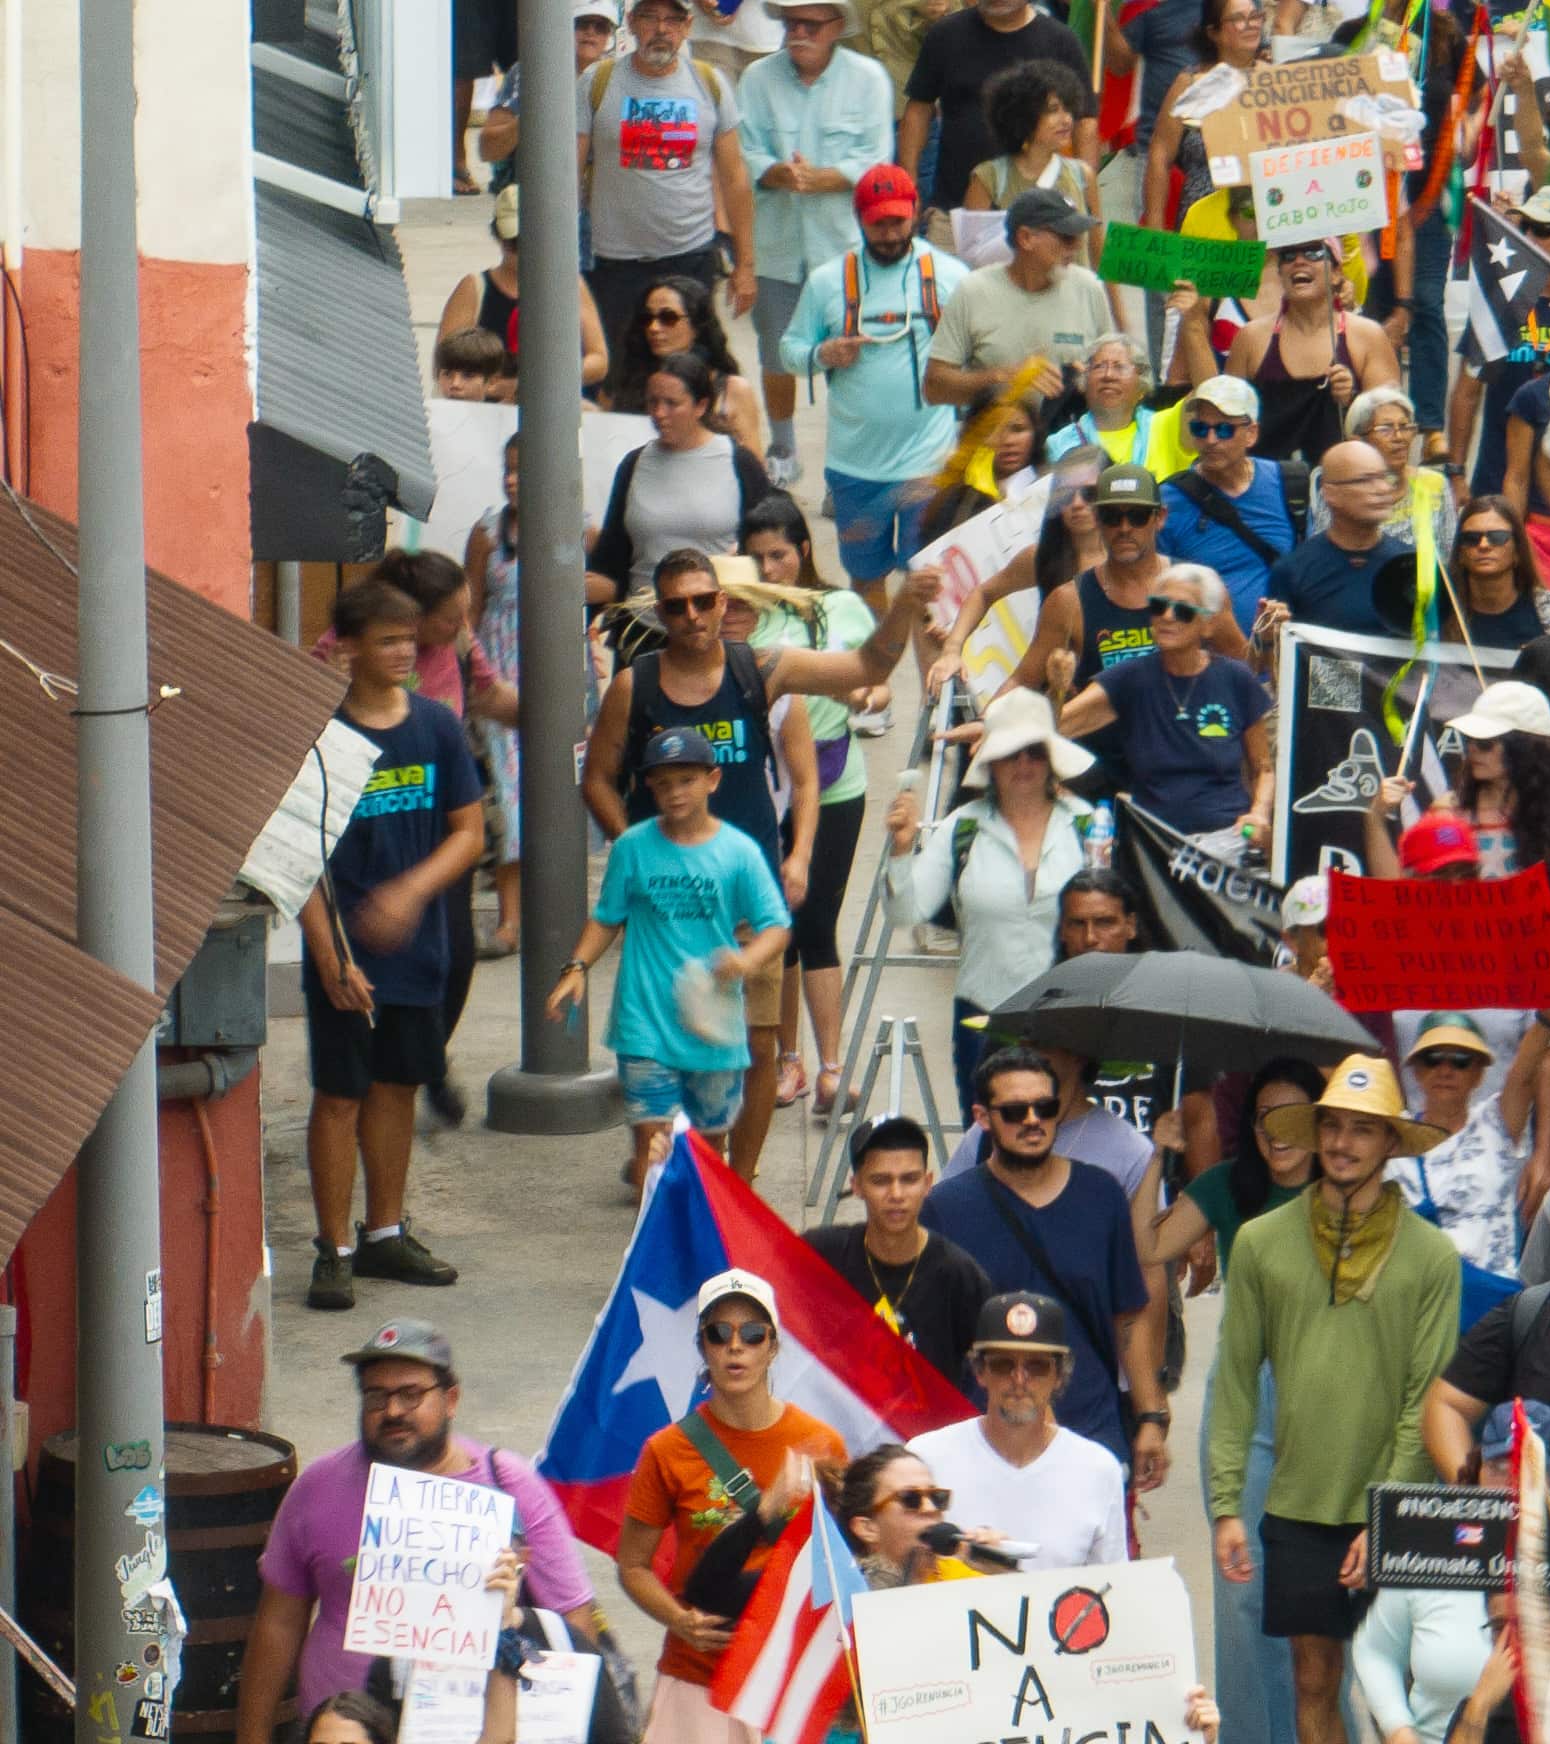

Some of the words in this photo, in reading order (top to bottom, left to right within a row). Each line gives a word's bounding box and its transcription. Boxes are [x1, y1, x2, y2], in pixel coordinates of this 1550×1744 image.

[1256, 107, 1312, 143] NO
[1328, 113, 1346, 133] a
[1263, 138, 1374, 178] DEFIENDE
[1305, 179, 1325, 196] A
[1266, 206, 1318, 230] CABO
[369, 1466, 403, 1510] LA
[416, 1478, 499, 1521] TIERRA
[431, 1592, 455, 1622] A
[351, 1616, 490, 1661] ESENCIA!
[1011, 1664, 1055, 1728] A
